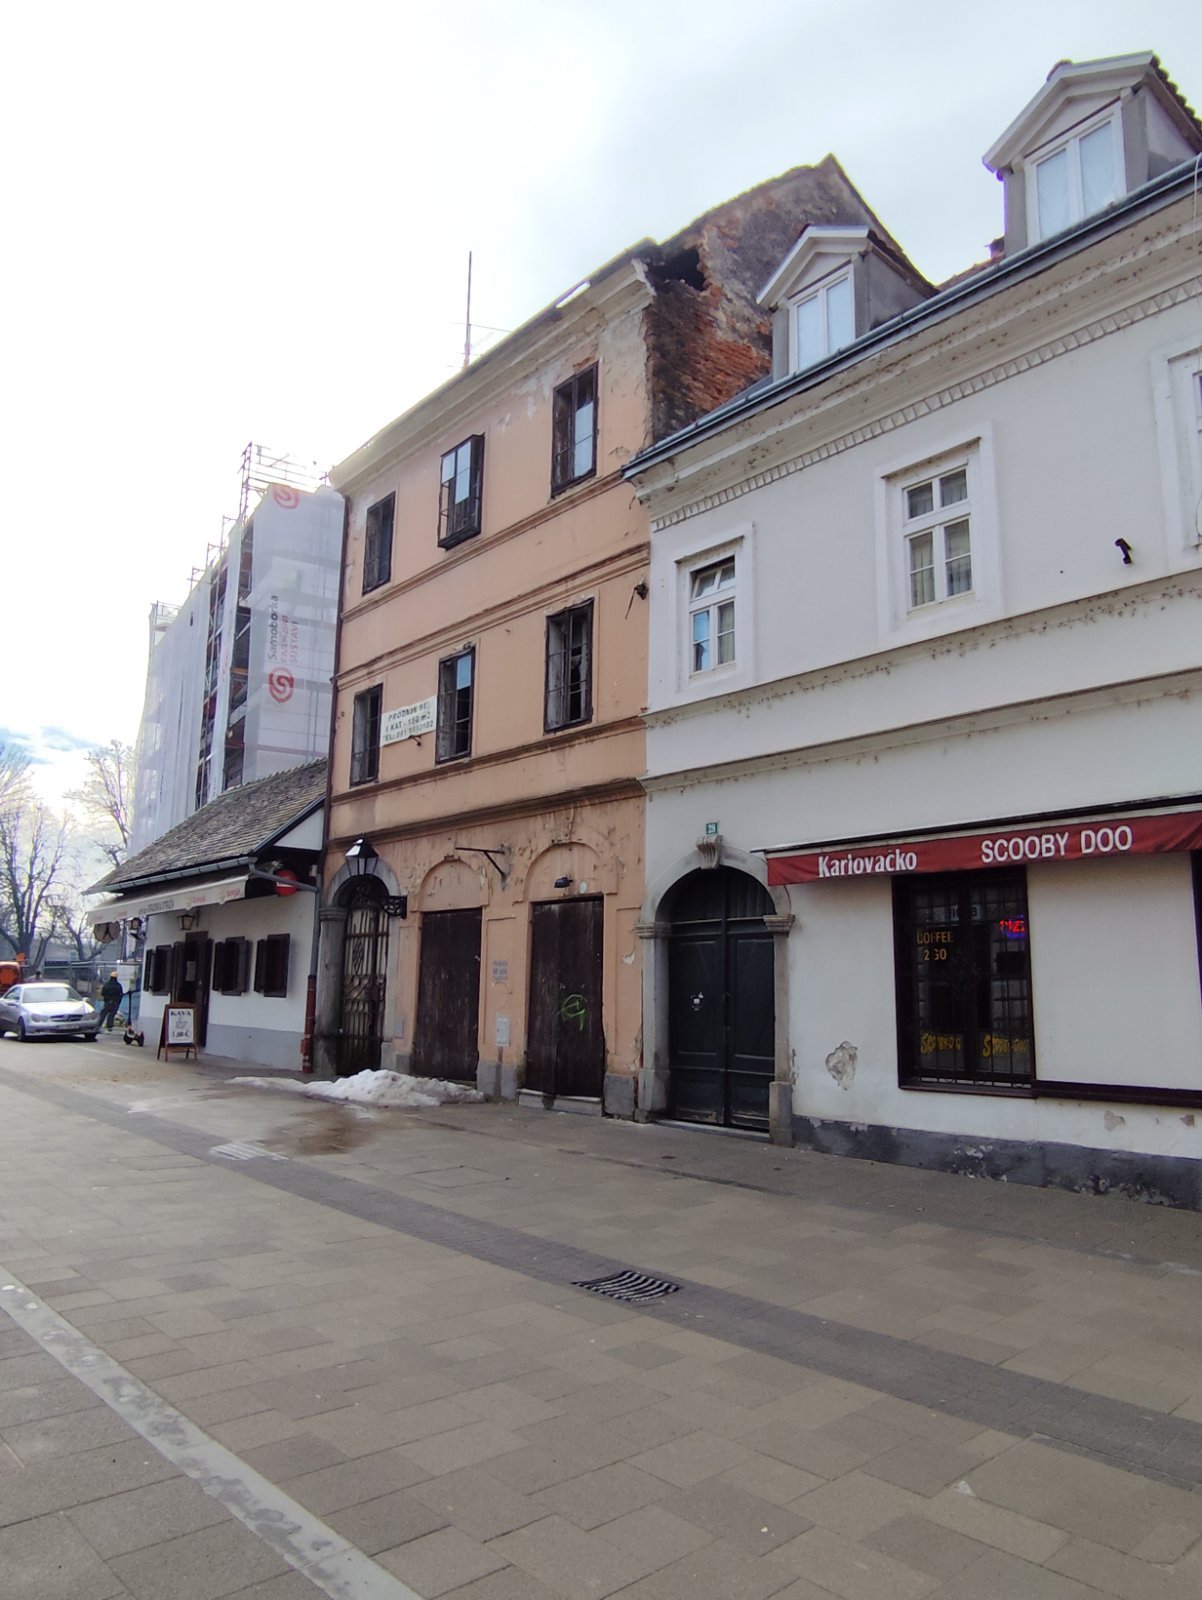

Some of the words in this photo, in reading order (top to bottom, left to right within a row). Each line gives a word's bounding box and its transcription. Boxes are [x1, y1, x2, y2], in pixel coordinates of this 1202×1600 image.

[267, 595, 279, 661] Samoborka
[981, 831, 1069, 864] SCOOBY
[1080, 825, 1133, 855] DOO
[923, 948, 931, 961] 2
